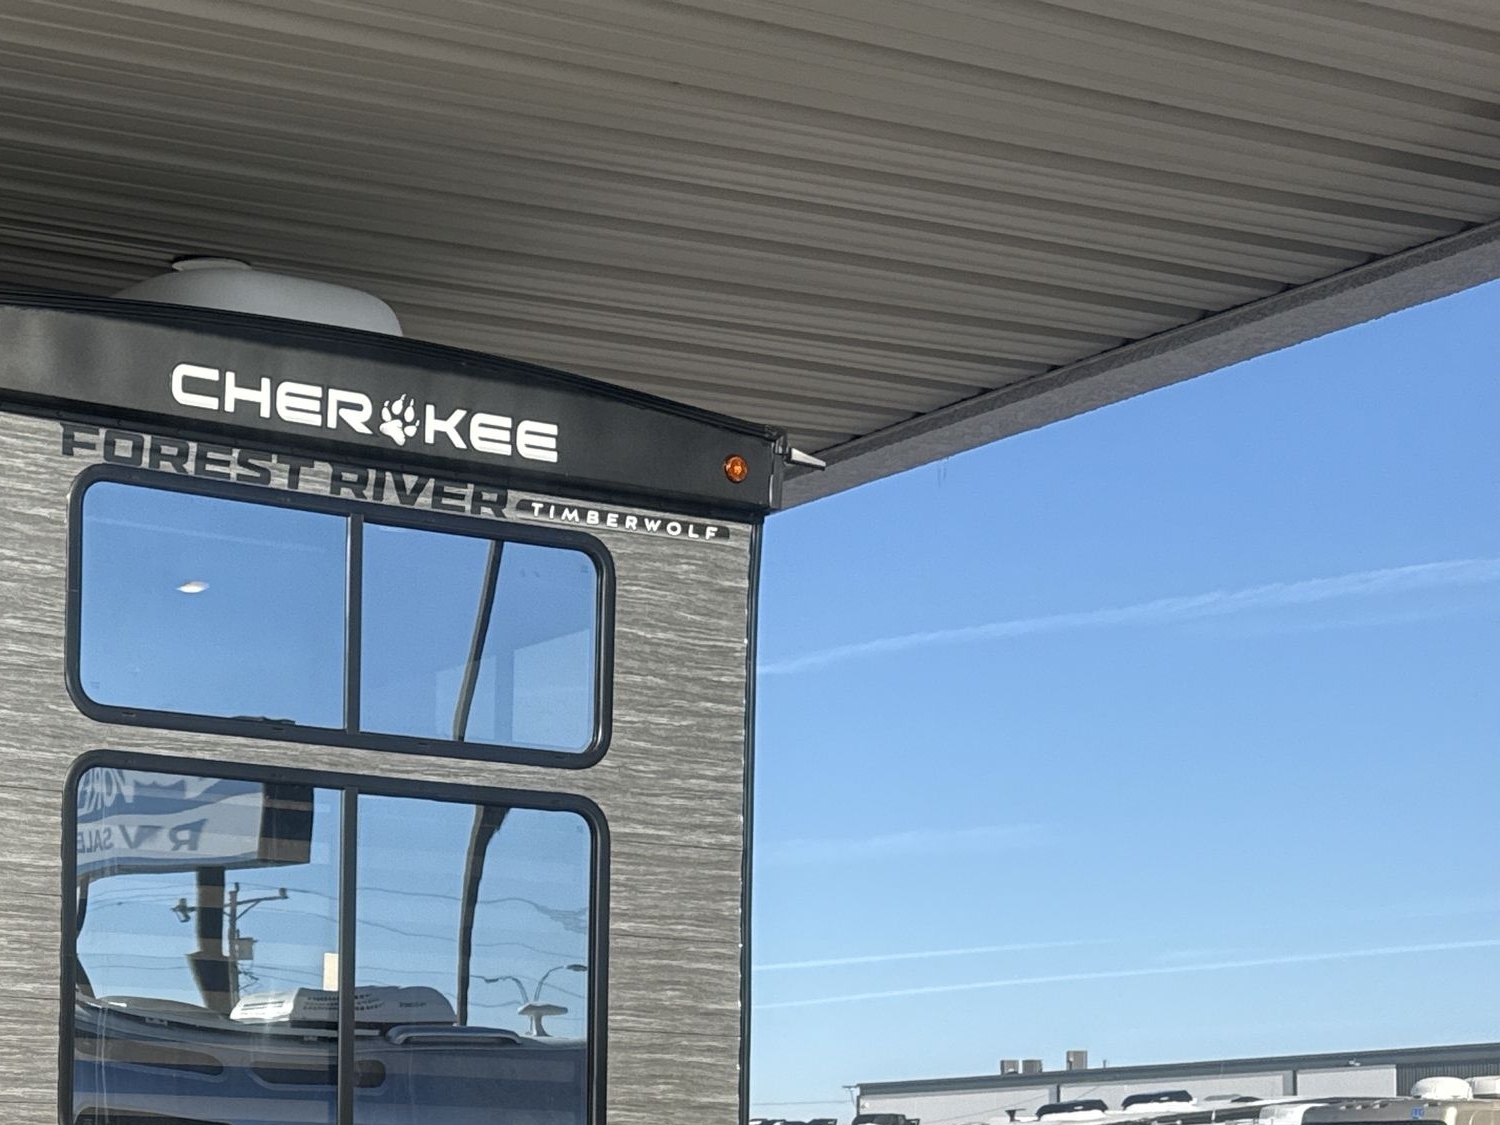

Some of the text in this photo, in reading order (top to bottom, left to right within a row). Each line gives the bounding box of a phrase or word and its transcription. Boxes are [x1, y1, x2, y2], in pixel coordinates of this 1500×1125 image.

[62, 424, 510, 520] FOREST RIVER
[530, 502, 719, 540] TIMBERWOLF
